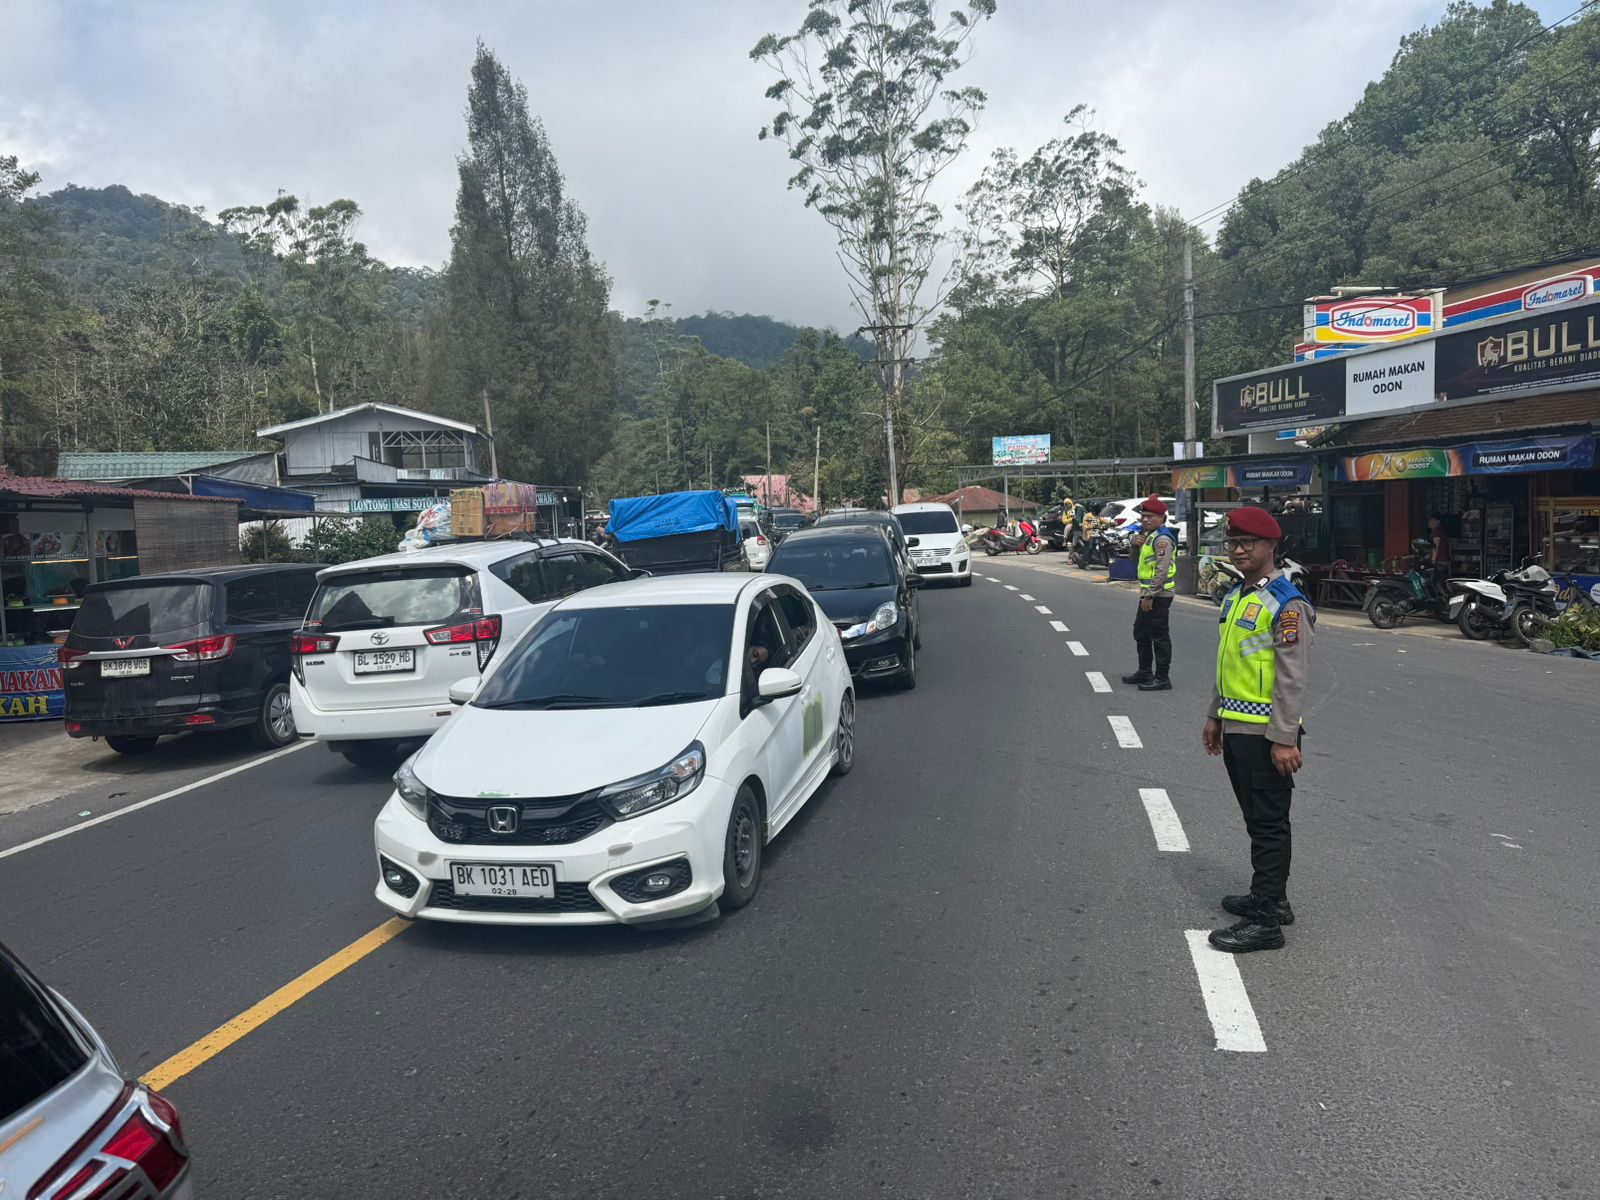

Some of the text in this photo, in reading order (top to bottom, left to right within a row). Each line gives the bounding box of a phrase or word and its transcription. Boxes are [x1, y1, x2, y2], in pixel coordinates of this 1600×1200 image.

[1527, 282, 1583, 306] Indomaret
[1336, 311, 1411, 328] Indomaret
[1506, 316, 1600, 363] BULL
[1353, 361, 1425, 383] RUMAH MAKAN
[1513, 360, 1546, 373] KUALITAS
[1549, 355, 1576, 367] BERANI
[1255, 376, 1310, 405] BULL
[1372, 380, 1403, 395] ODON
[1479, 450, 1561, 464] RUMAH MAKAN ODON
[353, 500, 389, 511] LONTONG
[394, 498, 412, 510] NASI
[412, 497, 433, 509] SOTO
[357, 651, 411, 666] BL 1529 HB
[456, 867, 550, 887] BK 1031 AED
